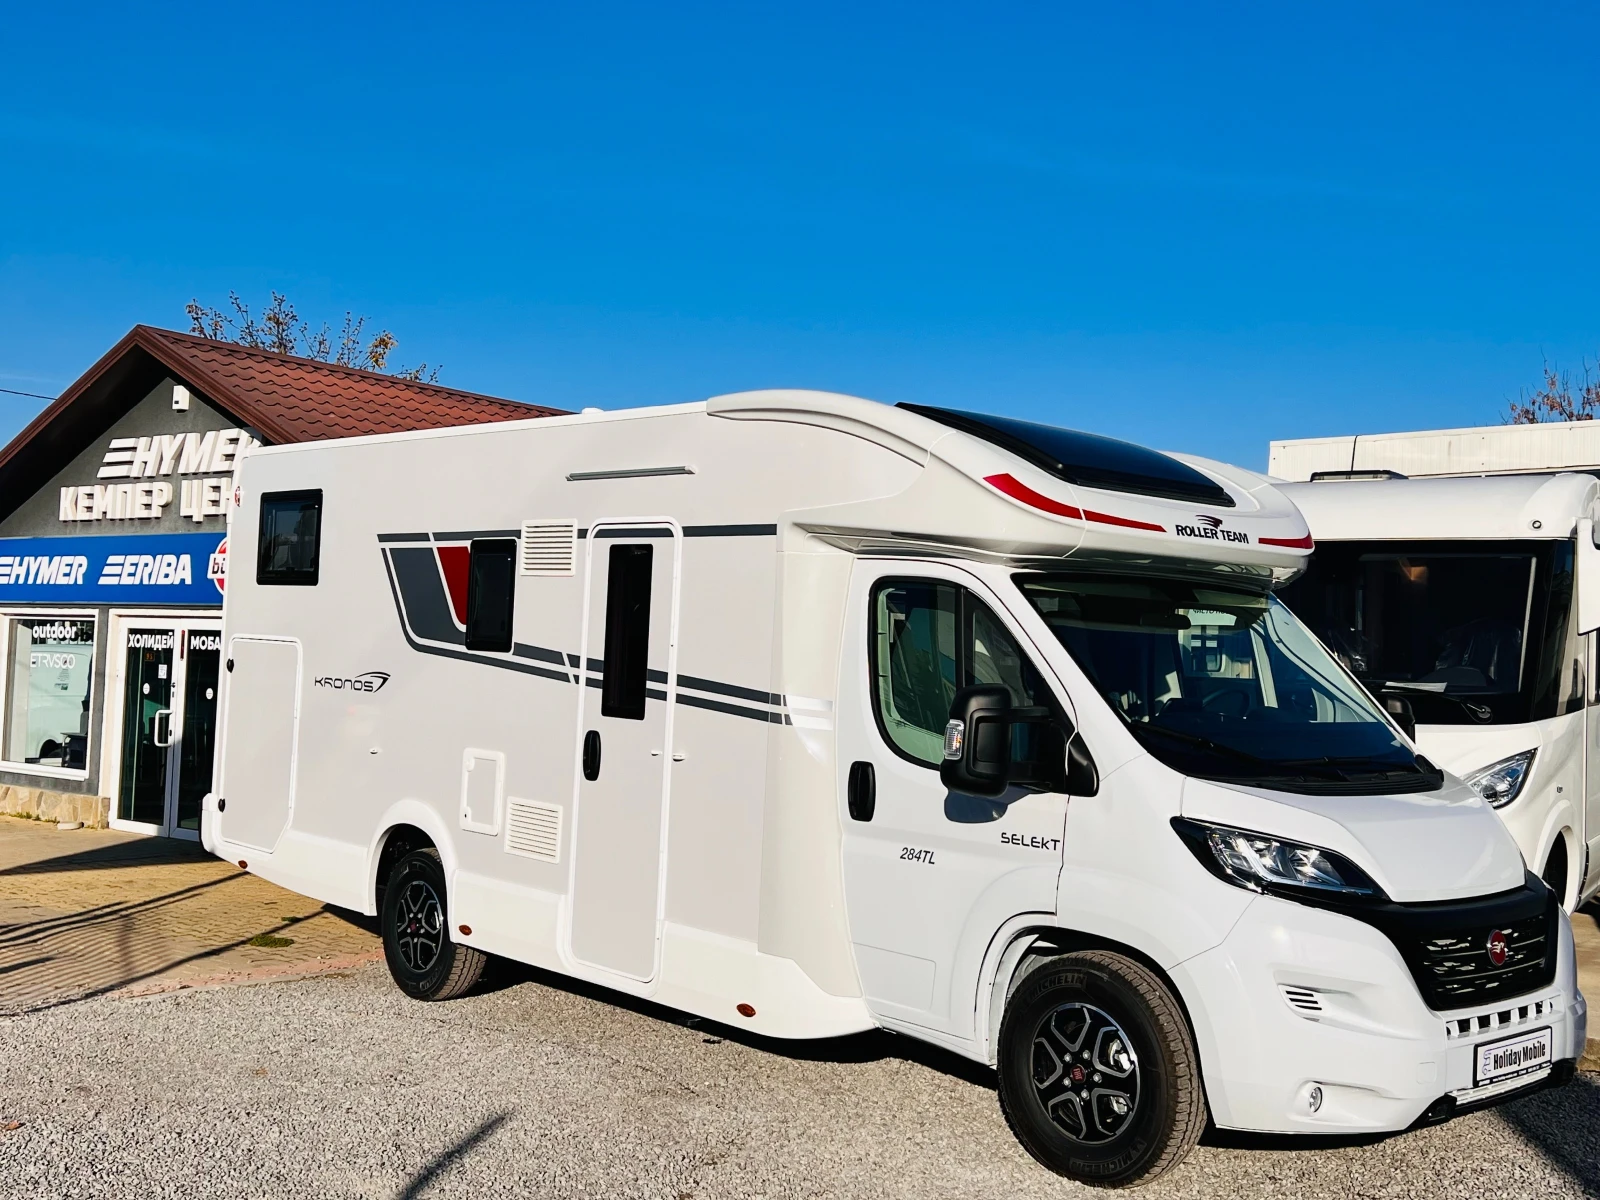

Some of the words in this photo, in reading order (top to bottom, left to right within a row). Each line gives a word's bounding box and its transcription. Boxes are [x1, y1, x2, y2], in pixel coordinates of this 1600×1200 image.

[59, 481, 173, 521] КЕМПЕР
[1175, 524, 1219, 540] ROLLER
[1219, 529, 1250, 544] TEAM
[8, 555, 88, 585] HYMER
[114, 554, 192, 585] ERIBA
[32, 621, 77, 639] outdoor
[127, 631, 174, 651] ХОЛИДЕЙ
[30, 653, 76, 669] ETRVSCO
[1000, 832, 1061, 851] SELEKT
[899, 847, 936, 865] 284TL
[1493, 1048, 1522, 1071] Holiday
[1522, 1040, 1546, 1063] Mobile
